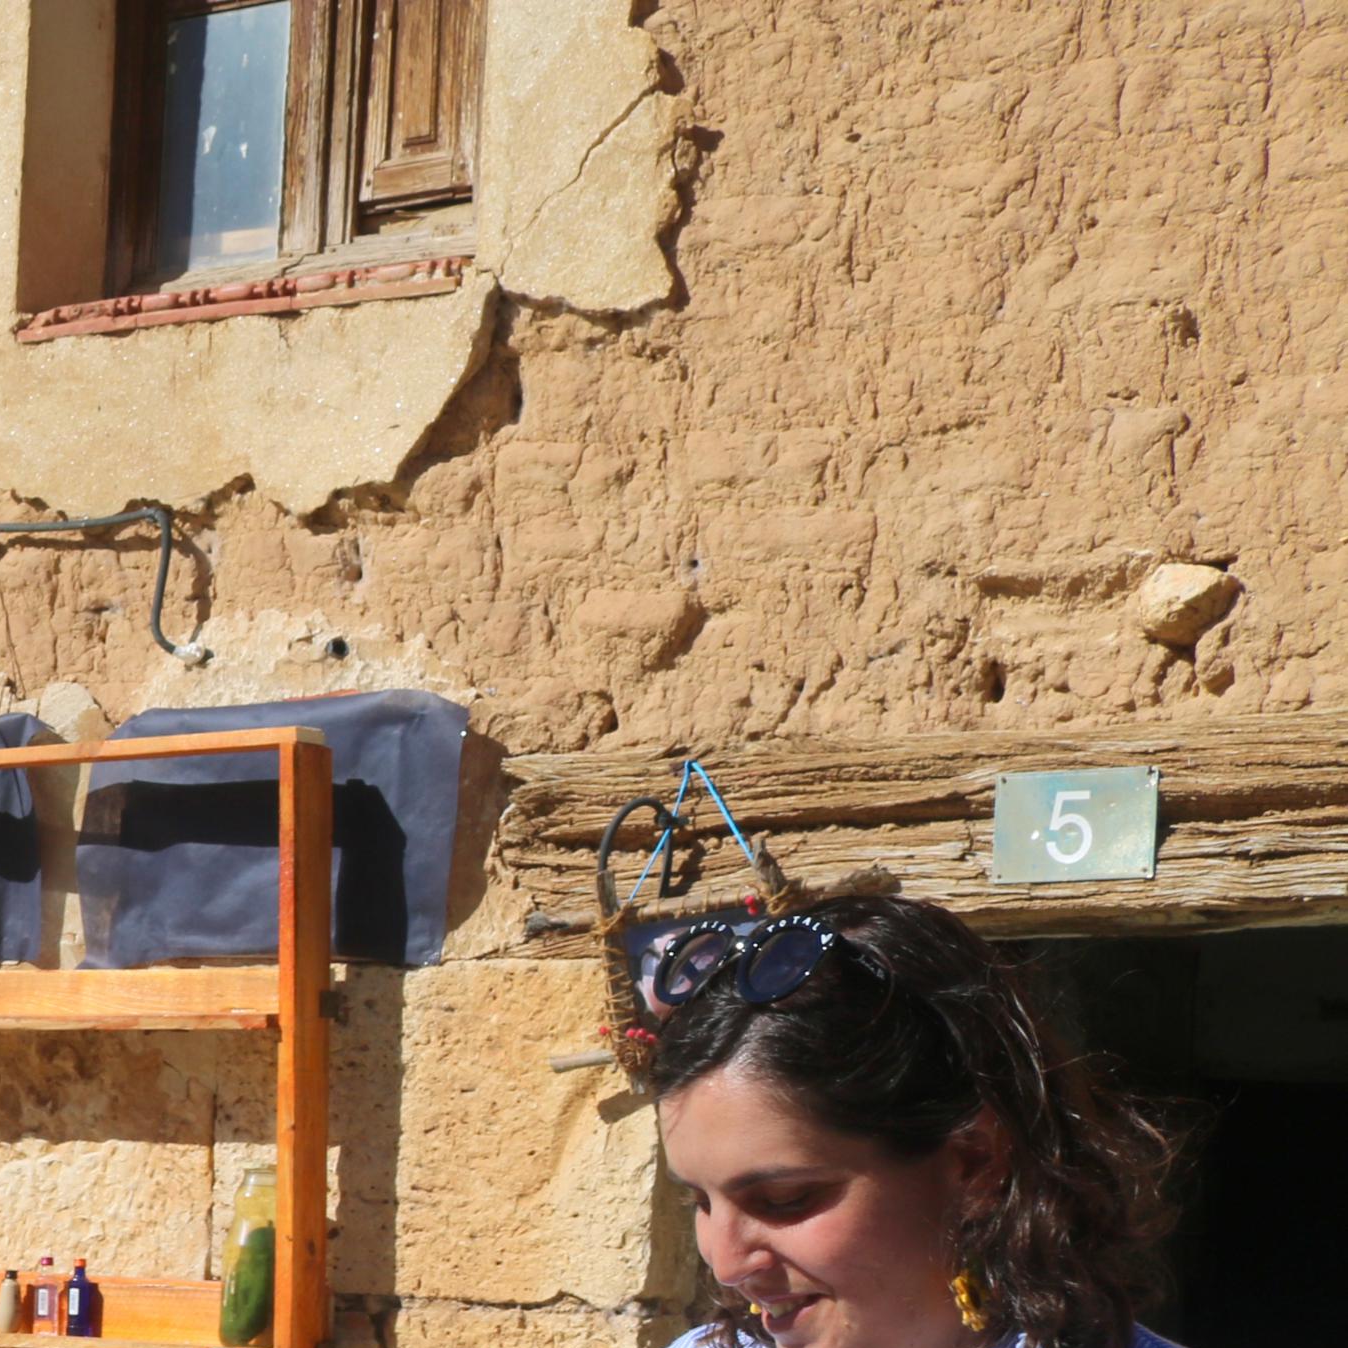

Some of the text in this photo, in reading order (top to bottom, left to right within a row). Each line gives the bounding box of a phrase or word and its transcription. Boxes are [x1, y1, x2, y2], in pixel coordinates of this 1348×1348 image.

[1045, 789, 1093, 865] 5
[689, 915, 821, 934] PASO TOTAL
